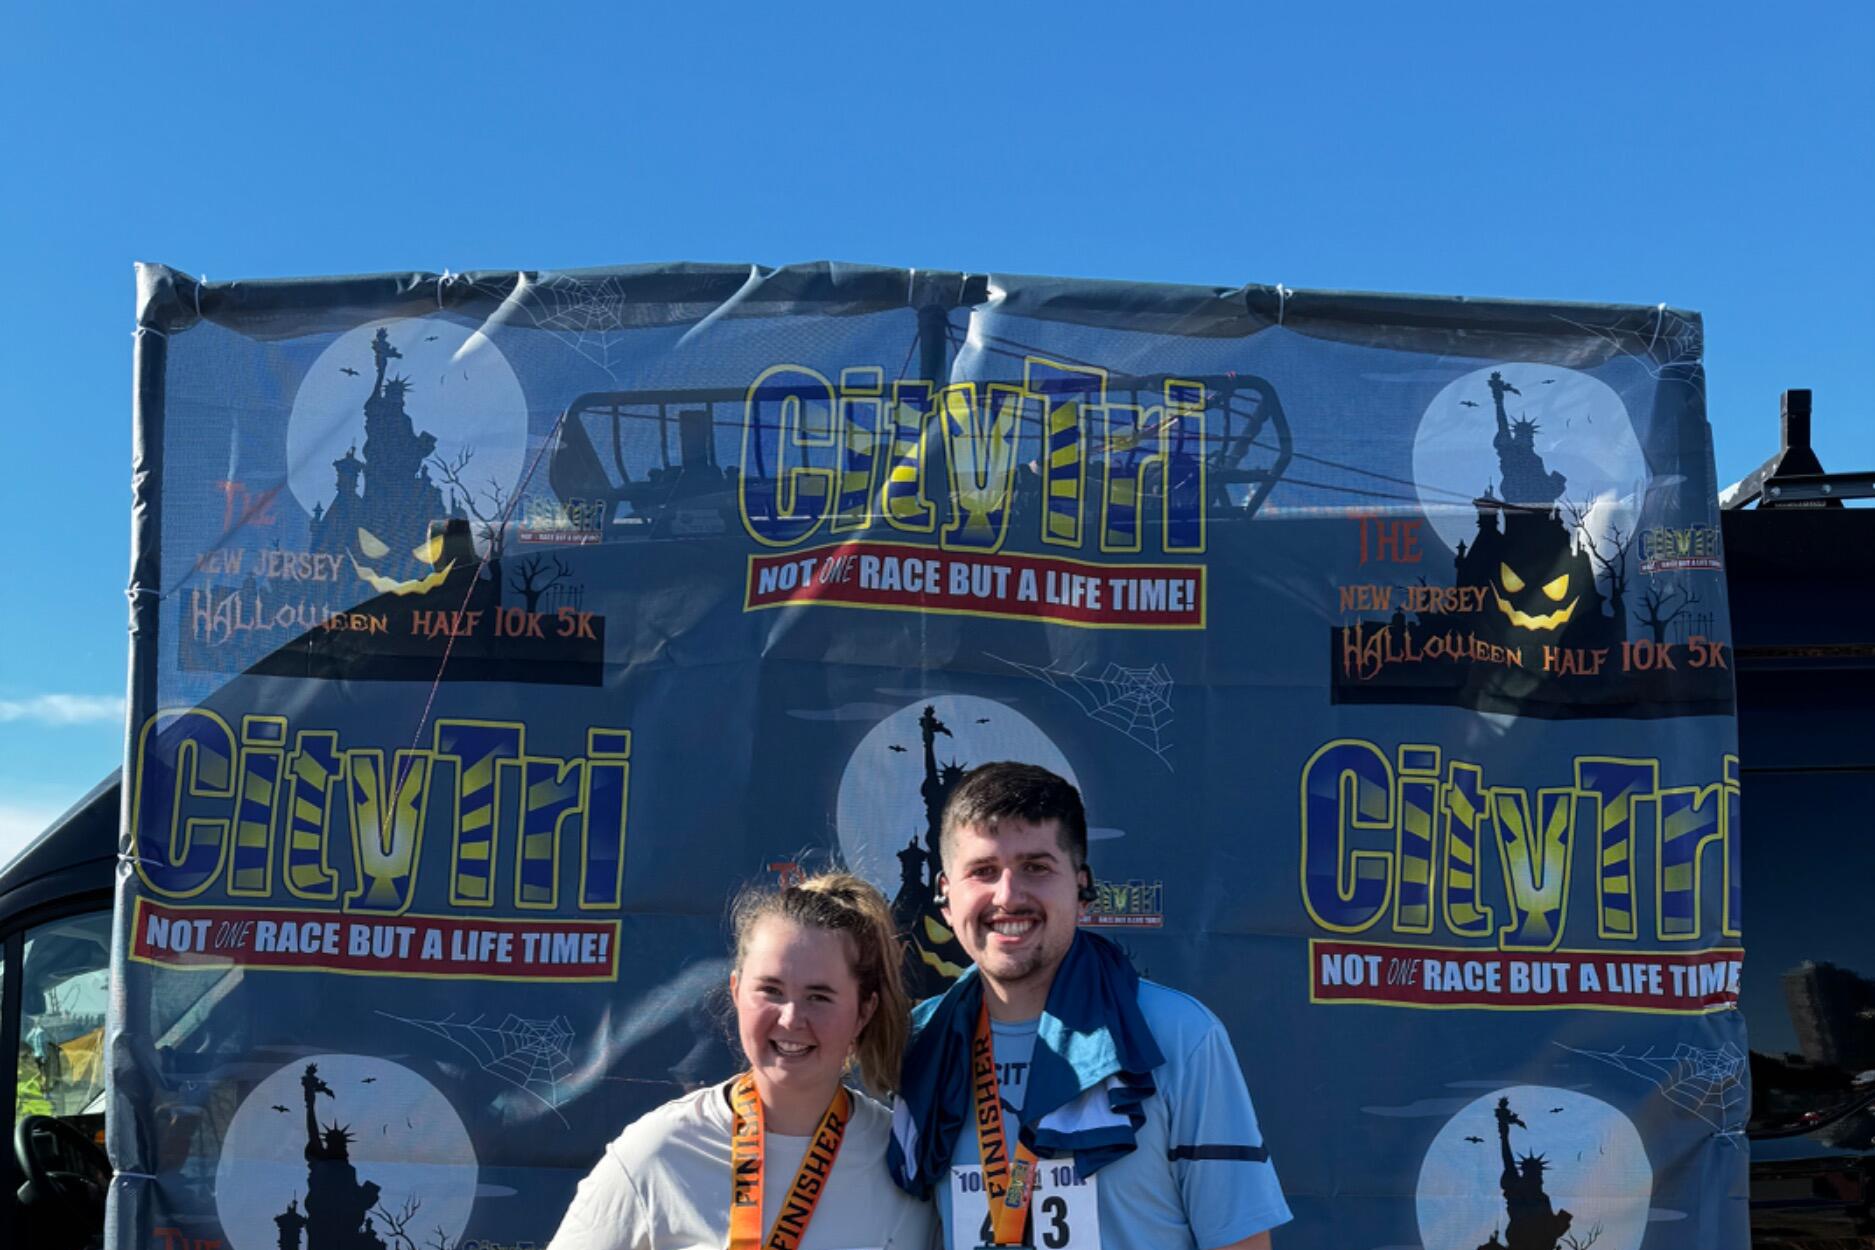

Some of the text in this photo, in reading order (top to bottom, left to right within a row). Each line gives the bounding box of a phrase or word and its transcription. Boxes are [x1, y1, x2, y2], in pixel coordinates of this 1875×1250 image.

[739, 356, 1207, 554] CityTri
[195, 548, 345, 582] NEW JERSEY
[1346, 512, 1424, 567] THE
[757, 553, 1196, 612] NOT ONE RACE BUT A LIFE TIME!
[1339, 584, 1489, 615] NEW JERSEY
[190, 588, 597, 648] HALLOWEEN HALF 10K 5K
[1342, 616, 1728, 680] HALLOWEEN HALF 10K 5K
[131, 707, 633, 916] CityTri
[146, 914, 609, 965] NOT ONE RACE BUT A LIFE TIME!
[1320, 953, 1384, 988] NOT
[1386, 956, 1419, 988] ONE
[1422, 958, 1502, 993] RACE
[1509, 961, 1571, 995] BUT
[1579, 965, 1602, 993] A
[1606, 962, 1664, 996] LIFE
[974, 1033, 1008, 1199] FINISHER
